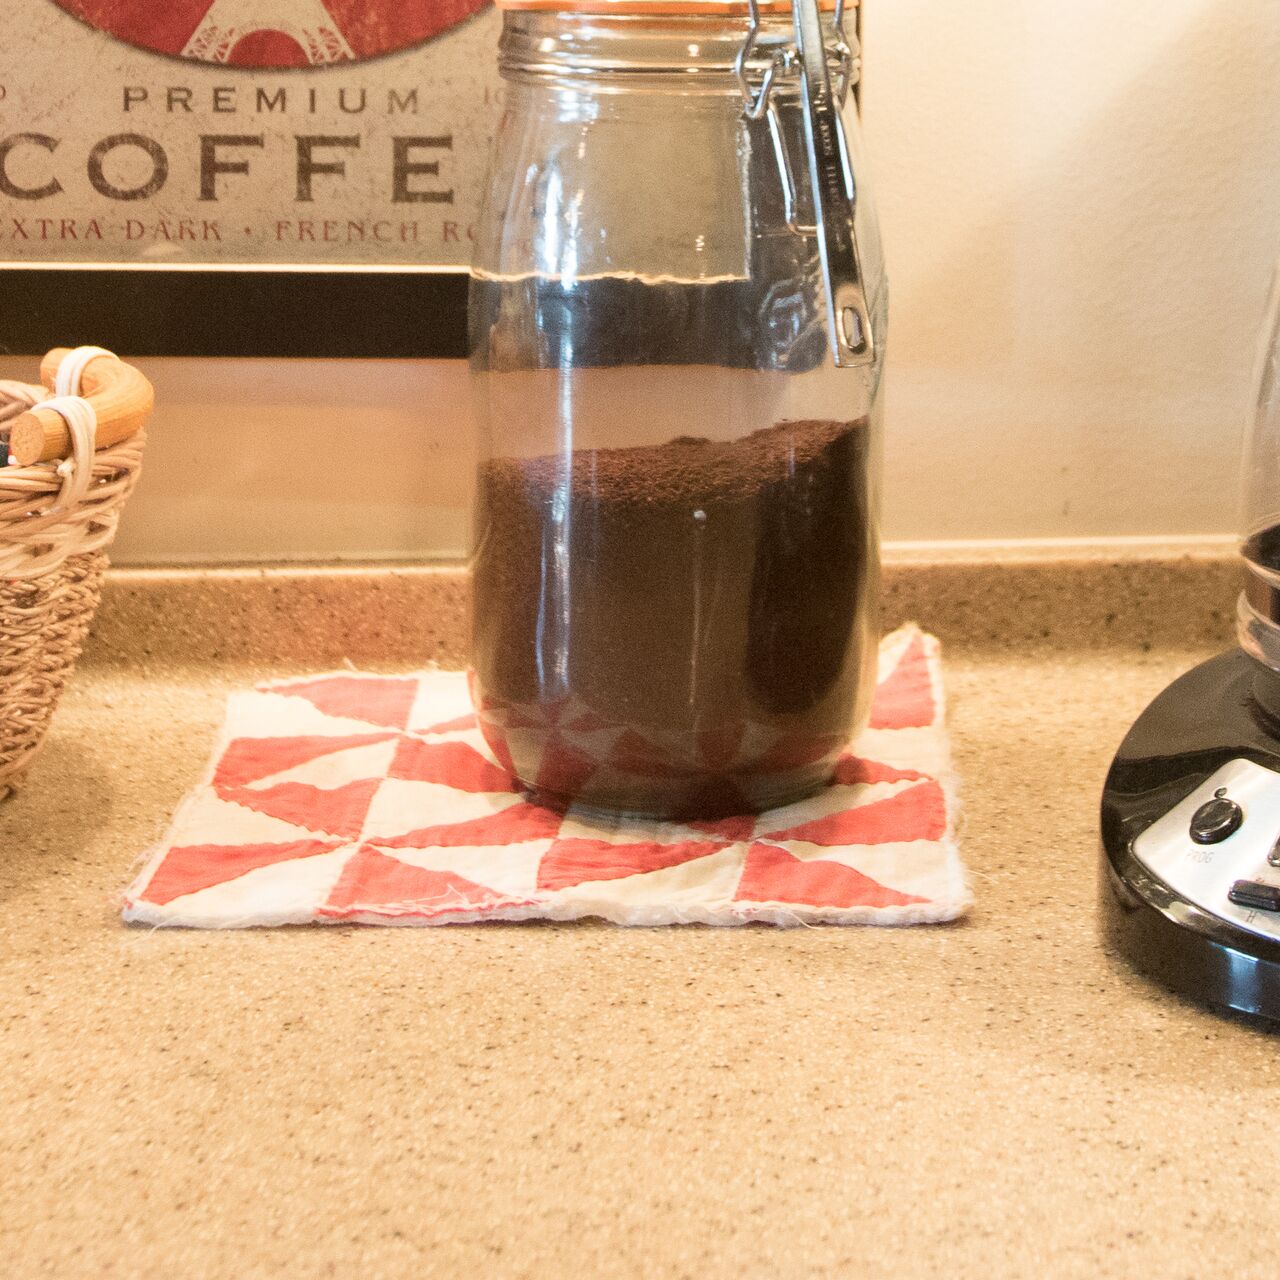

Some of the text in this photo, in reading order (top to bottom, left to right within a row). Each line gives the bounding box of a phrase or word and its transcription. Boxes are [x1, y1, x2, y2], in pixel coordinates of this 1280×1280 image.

[123, 86, 419, 114] PREMIUM
[125, 218, 221, 241] DARK
[276, 219, 421, 242] FRENCH
